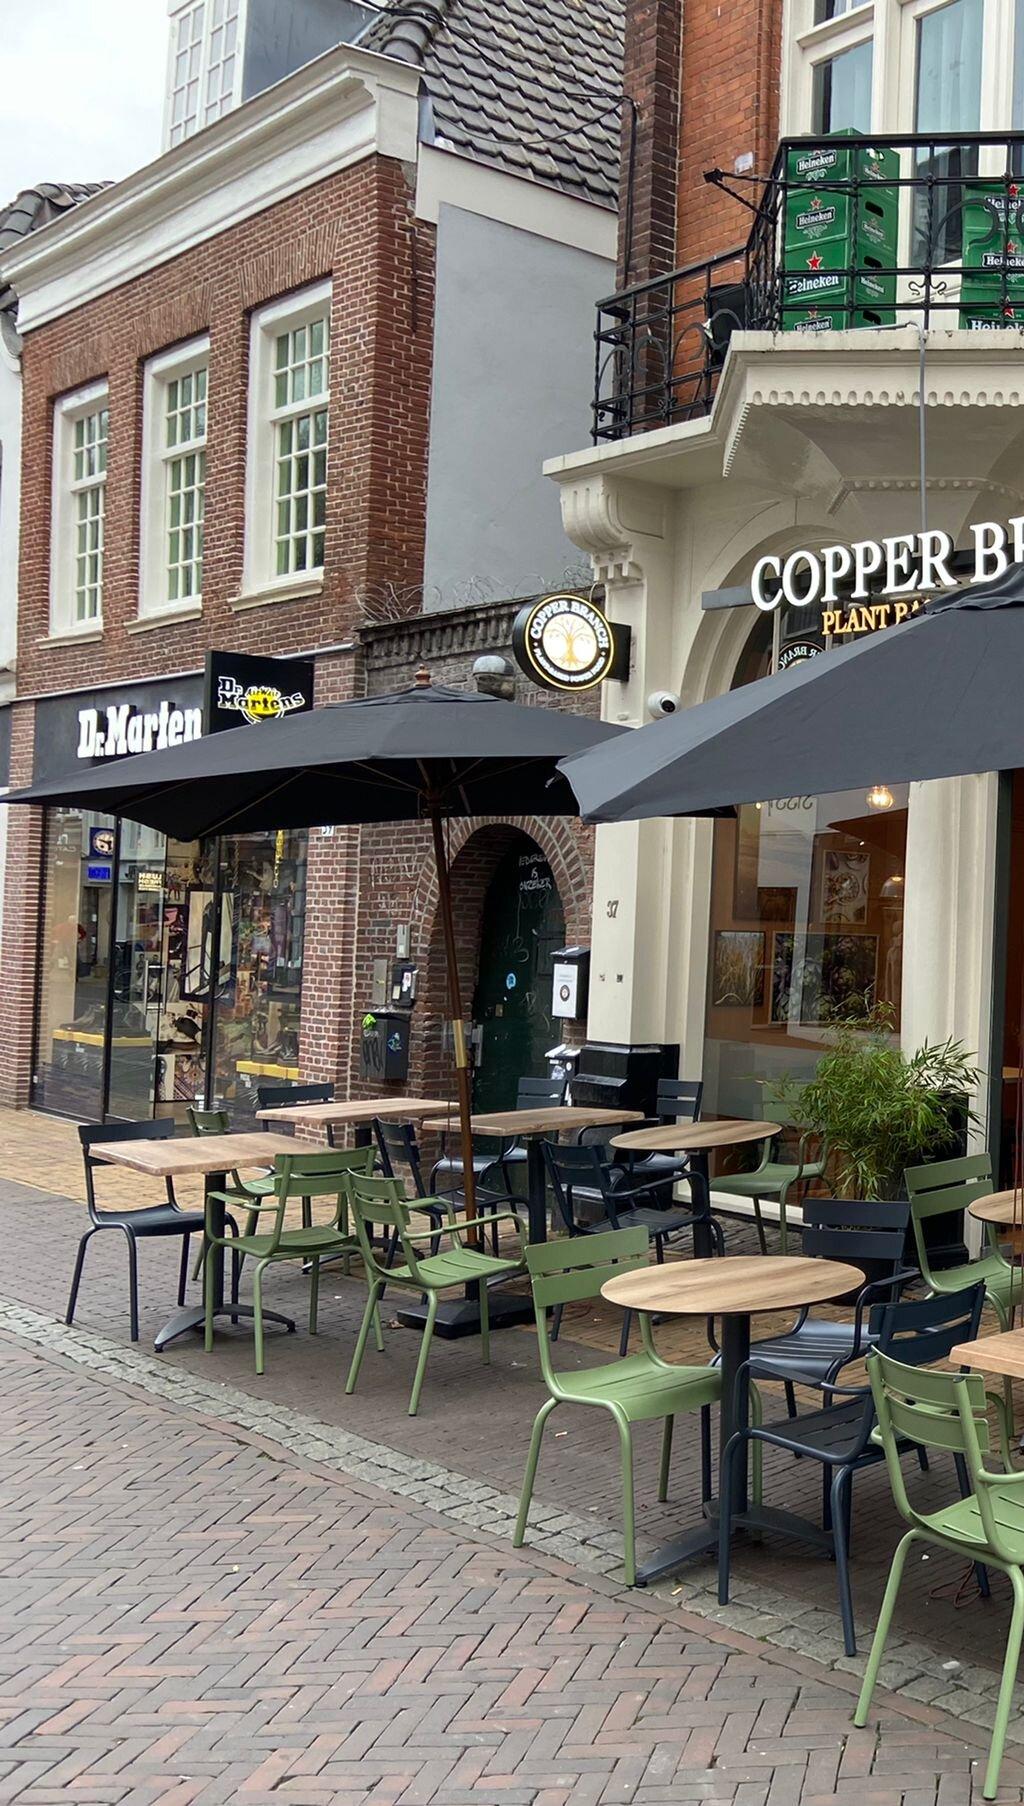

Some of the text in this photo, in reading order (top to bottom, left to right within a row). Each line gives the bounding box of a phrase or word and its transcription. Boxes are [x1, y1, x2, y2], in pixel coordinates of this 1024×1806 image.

[799, 154, 835, 171] Heineken
[799, 211, 834, 226] Heineken
[751, 529, 958, 612] COPPER
[530, 600, 609, 648] COPPER BRANCH
[822, 604, 890, 635] PLANT
[218, 692, 305, 711] Martens
[606, 900, 619, 918] 37
